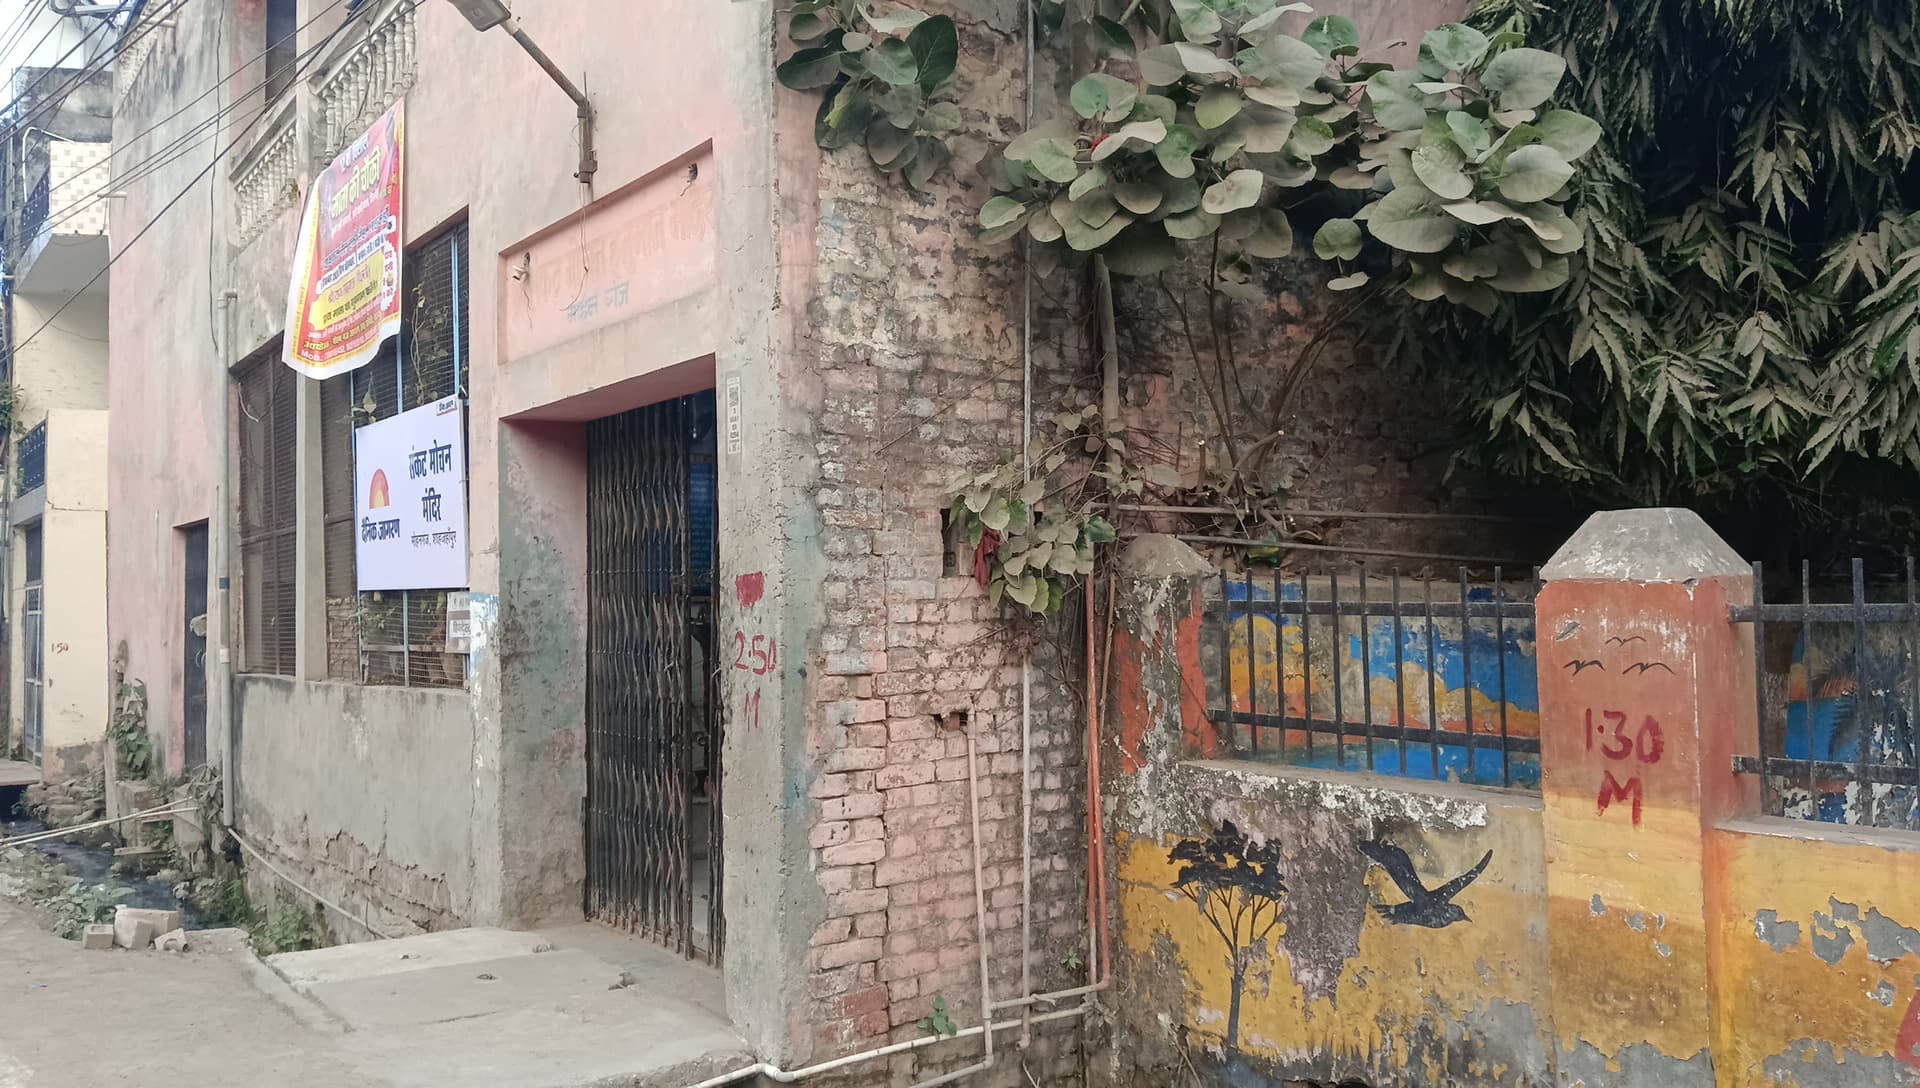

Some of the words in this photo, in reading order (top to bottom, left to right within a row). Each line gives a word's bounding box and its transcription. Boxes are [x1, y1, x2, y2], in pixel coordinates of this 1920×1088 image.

[348, 164, 361, 203] की
[408, 444, 427, 480] संकट
[428, 439, 452, 475] मोचन
[421, 487, 442, 522] मंदिर
[361, 516, 377, 543] दैनिक
[378, 518, 400, 541] जागरण
[1585, 708, 1665, 764] 1.30
[1597, 770, 1643, 827] M
